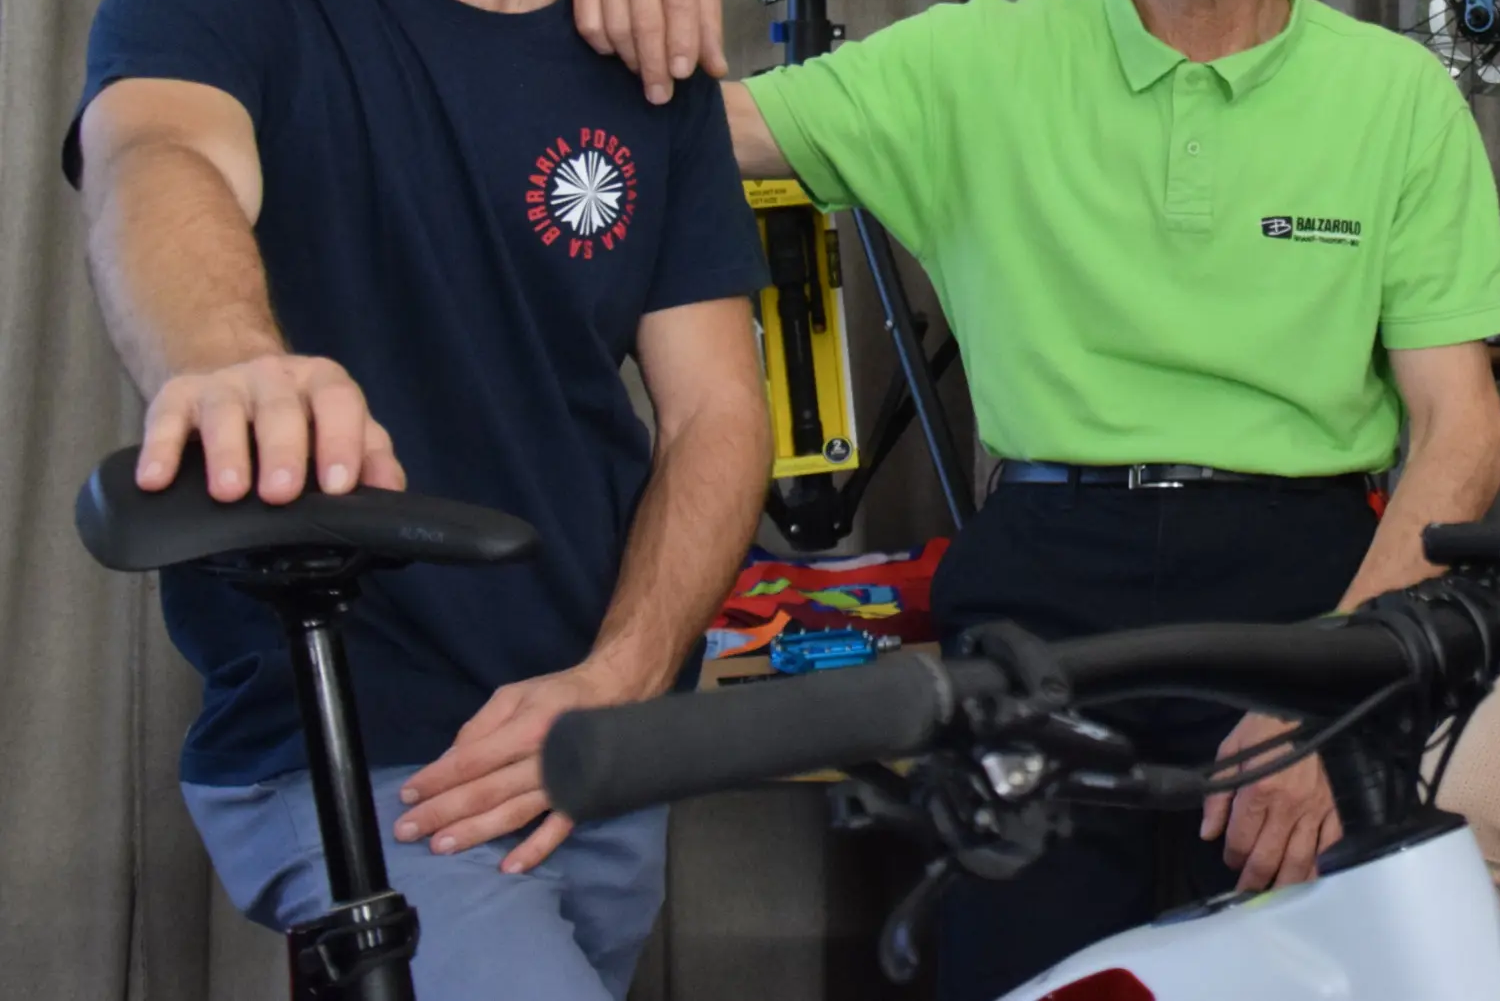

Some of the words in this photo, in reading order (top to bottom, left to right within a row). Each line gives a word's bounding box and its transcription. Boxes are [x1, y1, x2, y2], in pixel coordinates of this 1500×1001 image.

[525, 137, 572, 246] BIRRARIA
[568, 238, 594, 259] SA
[1296, 217, 1362, 236] BALZAROLO
